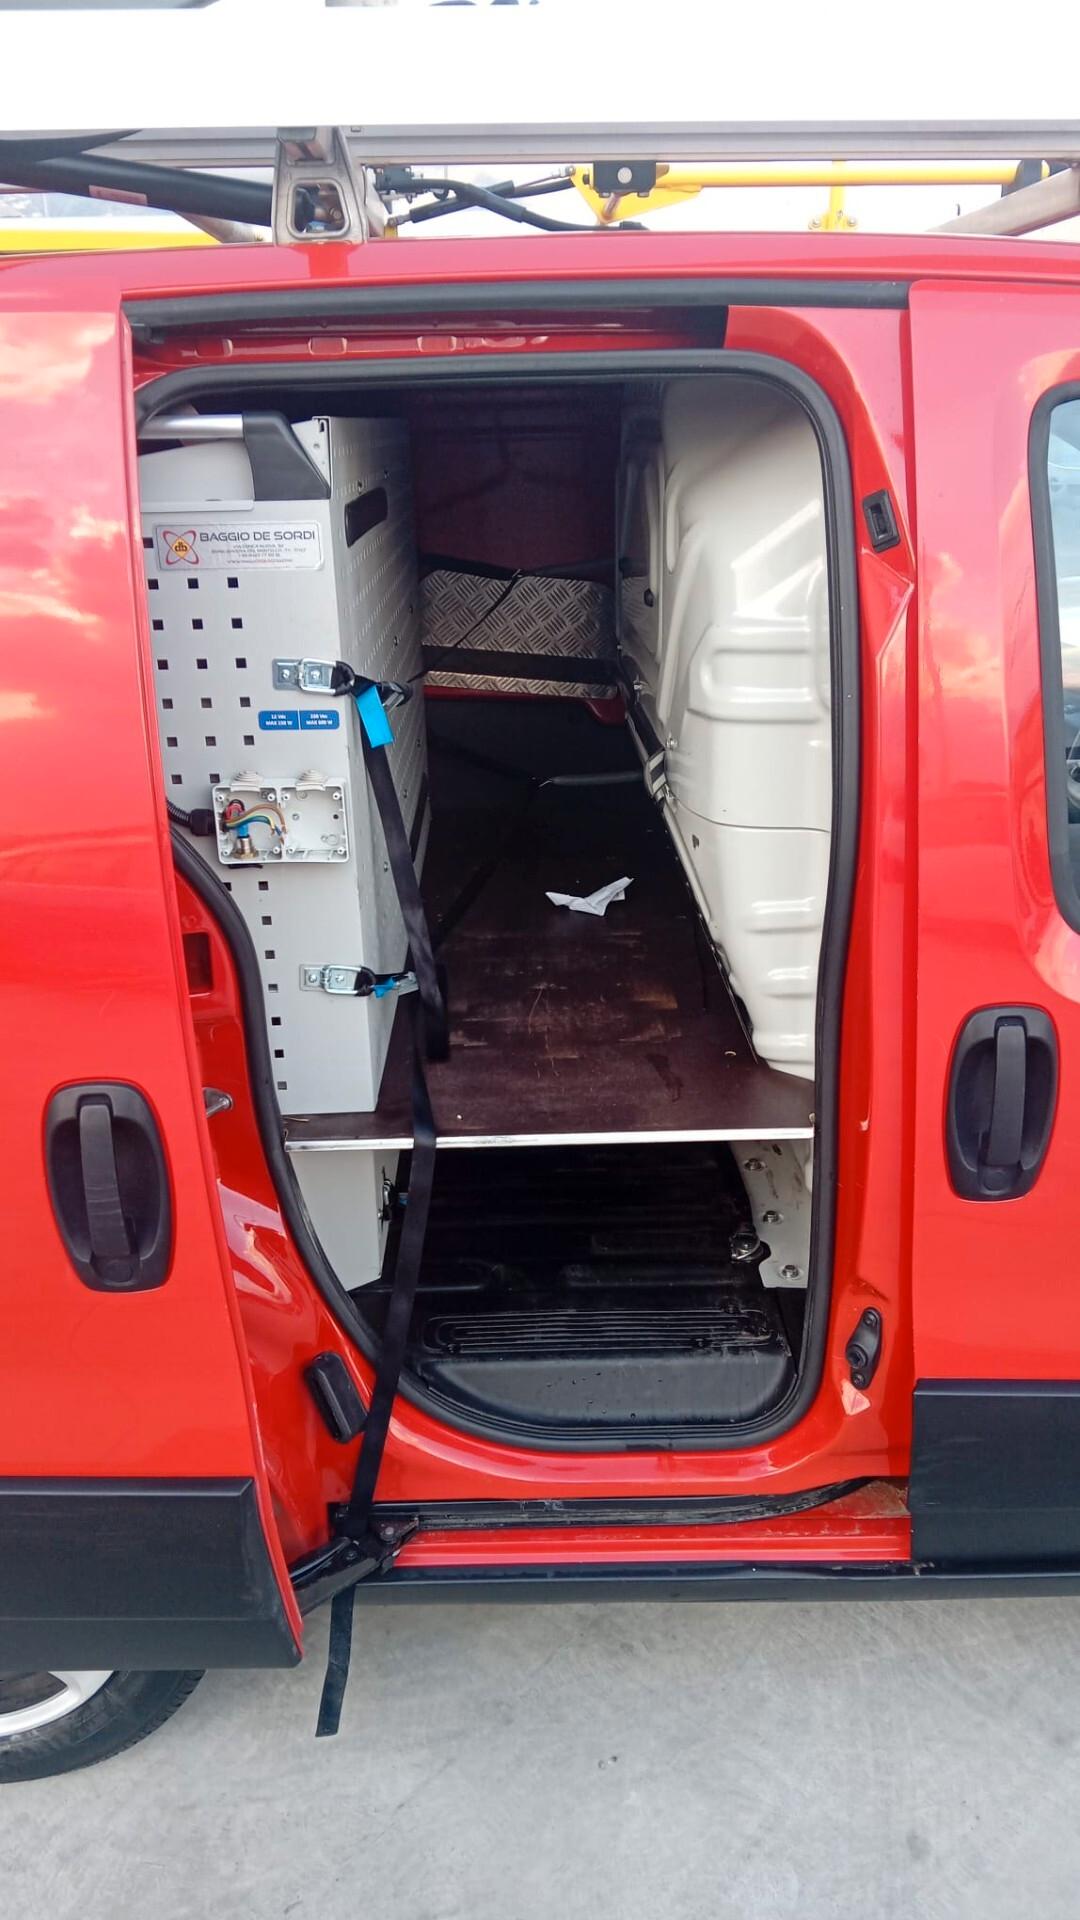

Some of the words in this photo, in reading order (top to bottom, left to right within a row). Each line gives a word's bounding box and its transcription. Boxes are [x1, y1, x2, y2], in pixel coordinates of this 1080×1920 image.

[199, 531, 250, 542] BAGGIO
[253, 531, 271, 541] DE
[274, 530, 315, 541] SORDI
